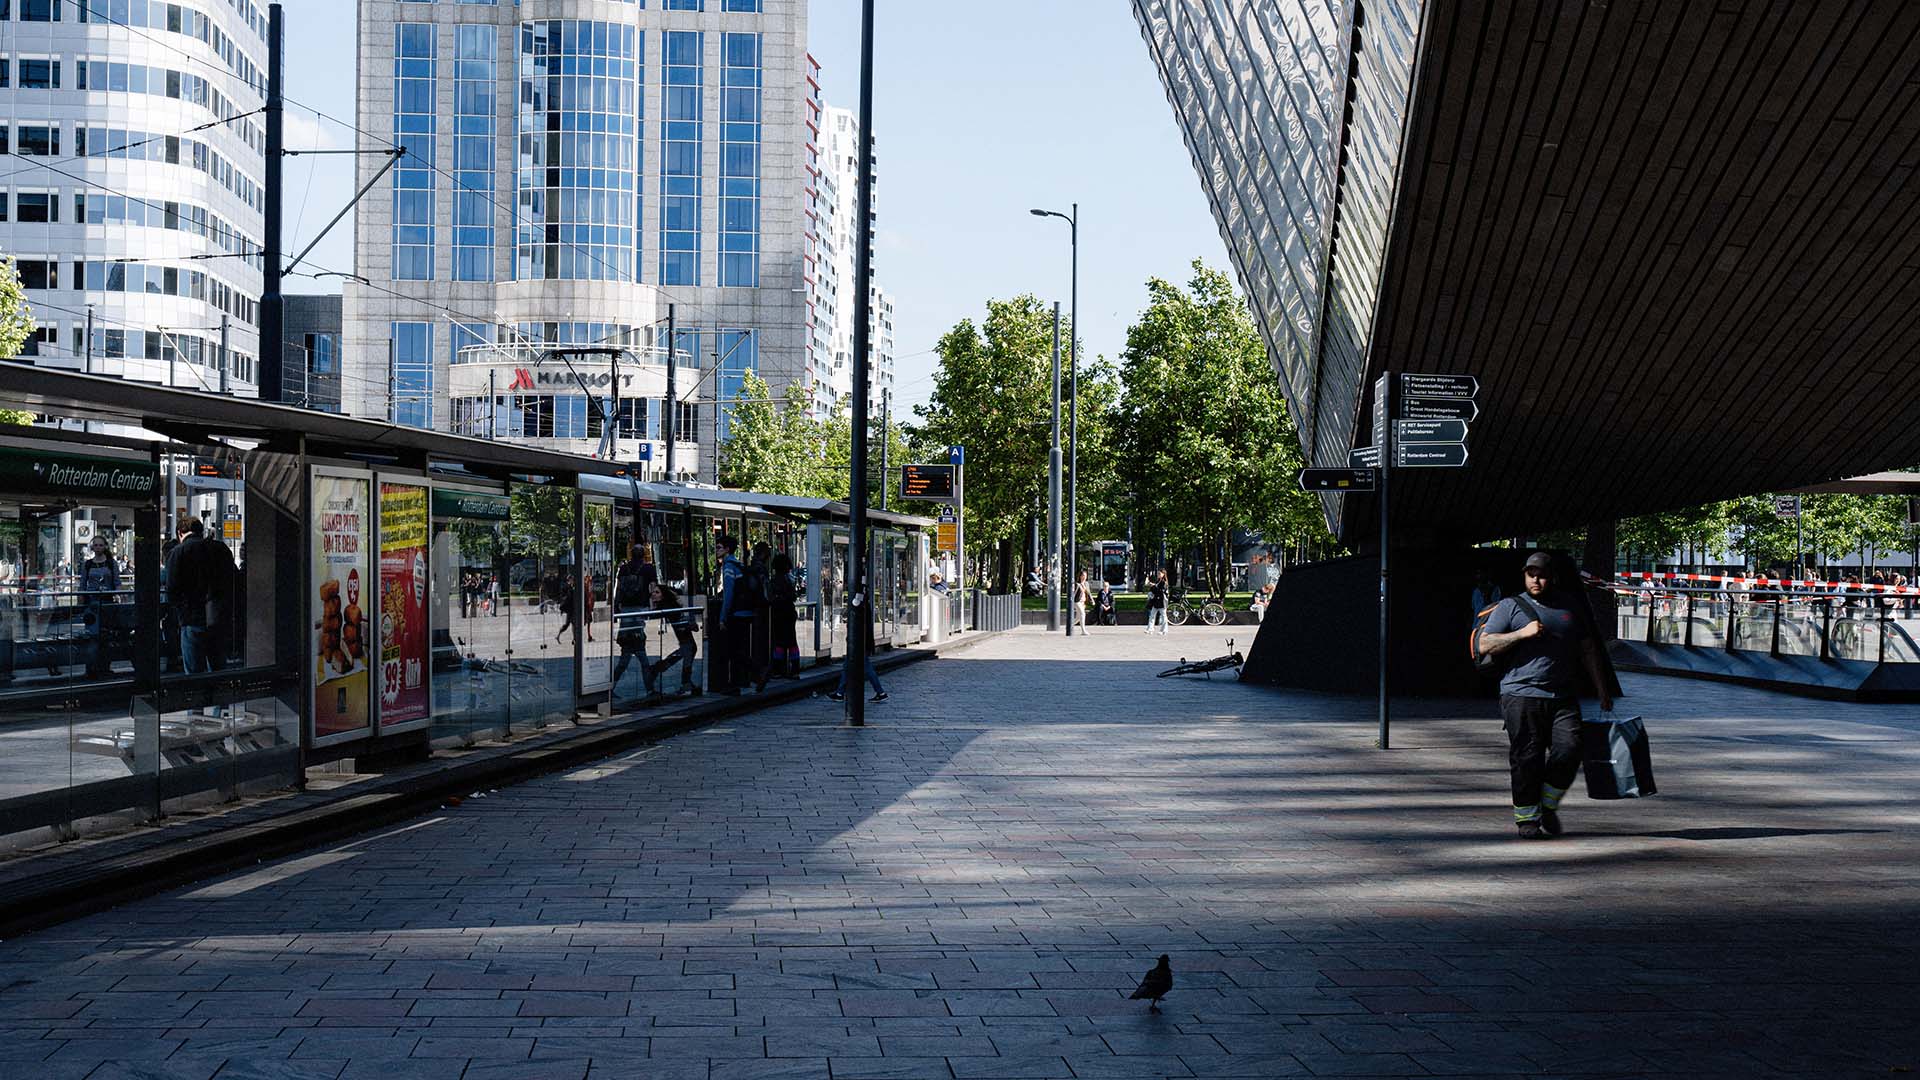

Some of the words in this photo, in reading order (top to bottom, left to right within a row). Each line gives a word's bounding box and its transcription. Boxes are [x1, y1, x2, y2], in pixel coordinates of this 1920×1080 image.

[641, 444, 648, 452] B
[951, 448, 959, 456] A
[48, 463, 109, 488] Rotterdam
[110, 468, 156, 492] Centraal
[324, 535, 334, 553] OM
[386, 662, 398, 693] 99
